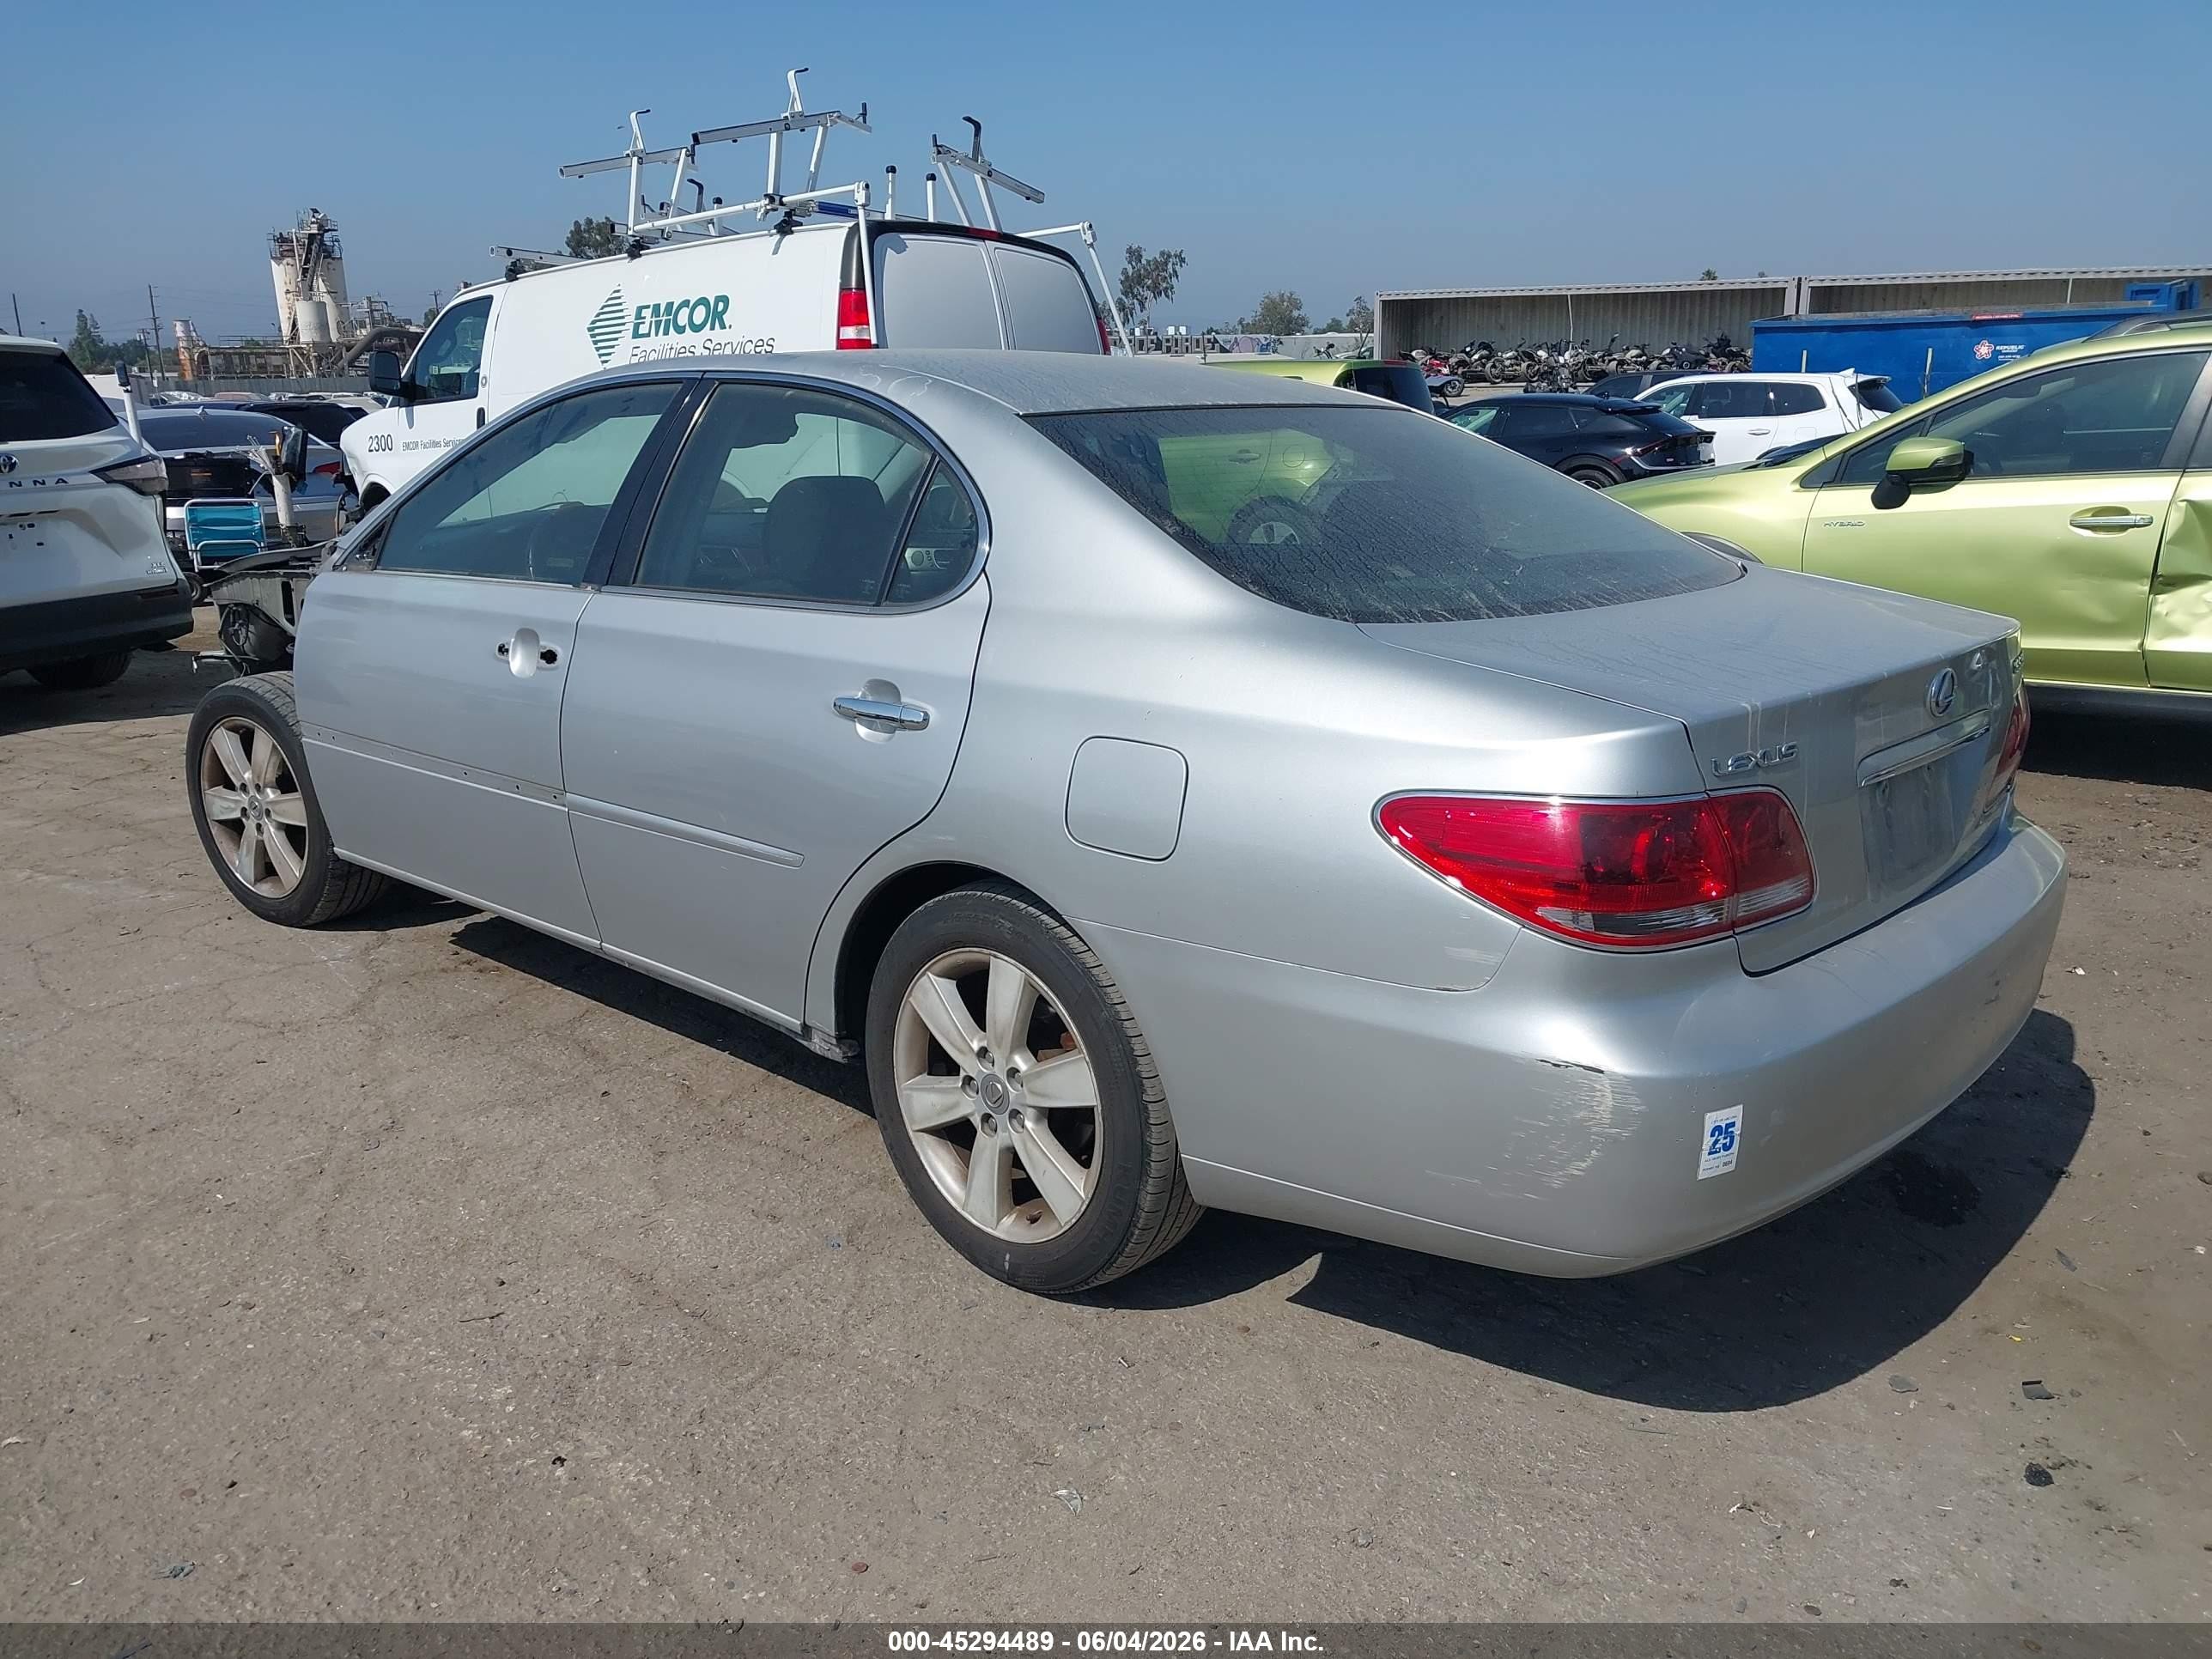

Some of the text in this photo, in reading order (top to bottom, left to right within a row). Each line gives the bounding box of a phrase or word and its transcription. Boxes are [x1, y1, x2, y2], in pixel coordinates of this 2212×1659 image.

[629, 335, 775, 364] Facilities Services
[368, 434, 393, 453] 2300
[1710, 741, 1799, 777] LEXUS
[1707, 1120, 1736, 1157] 25
